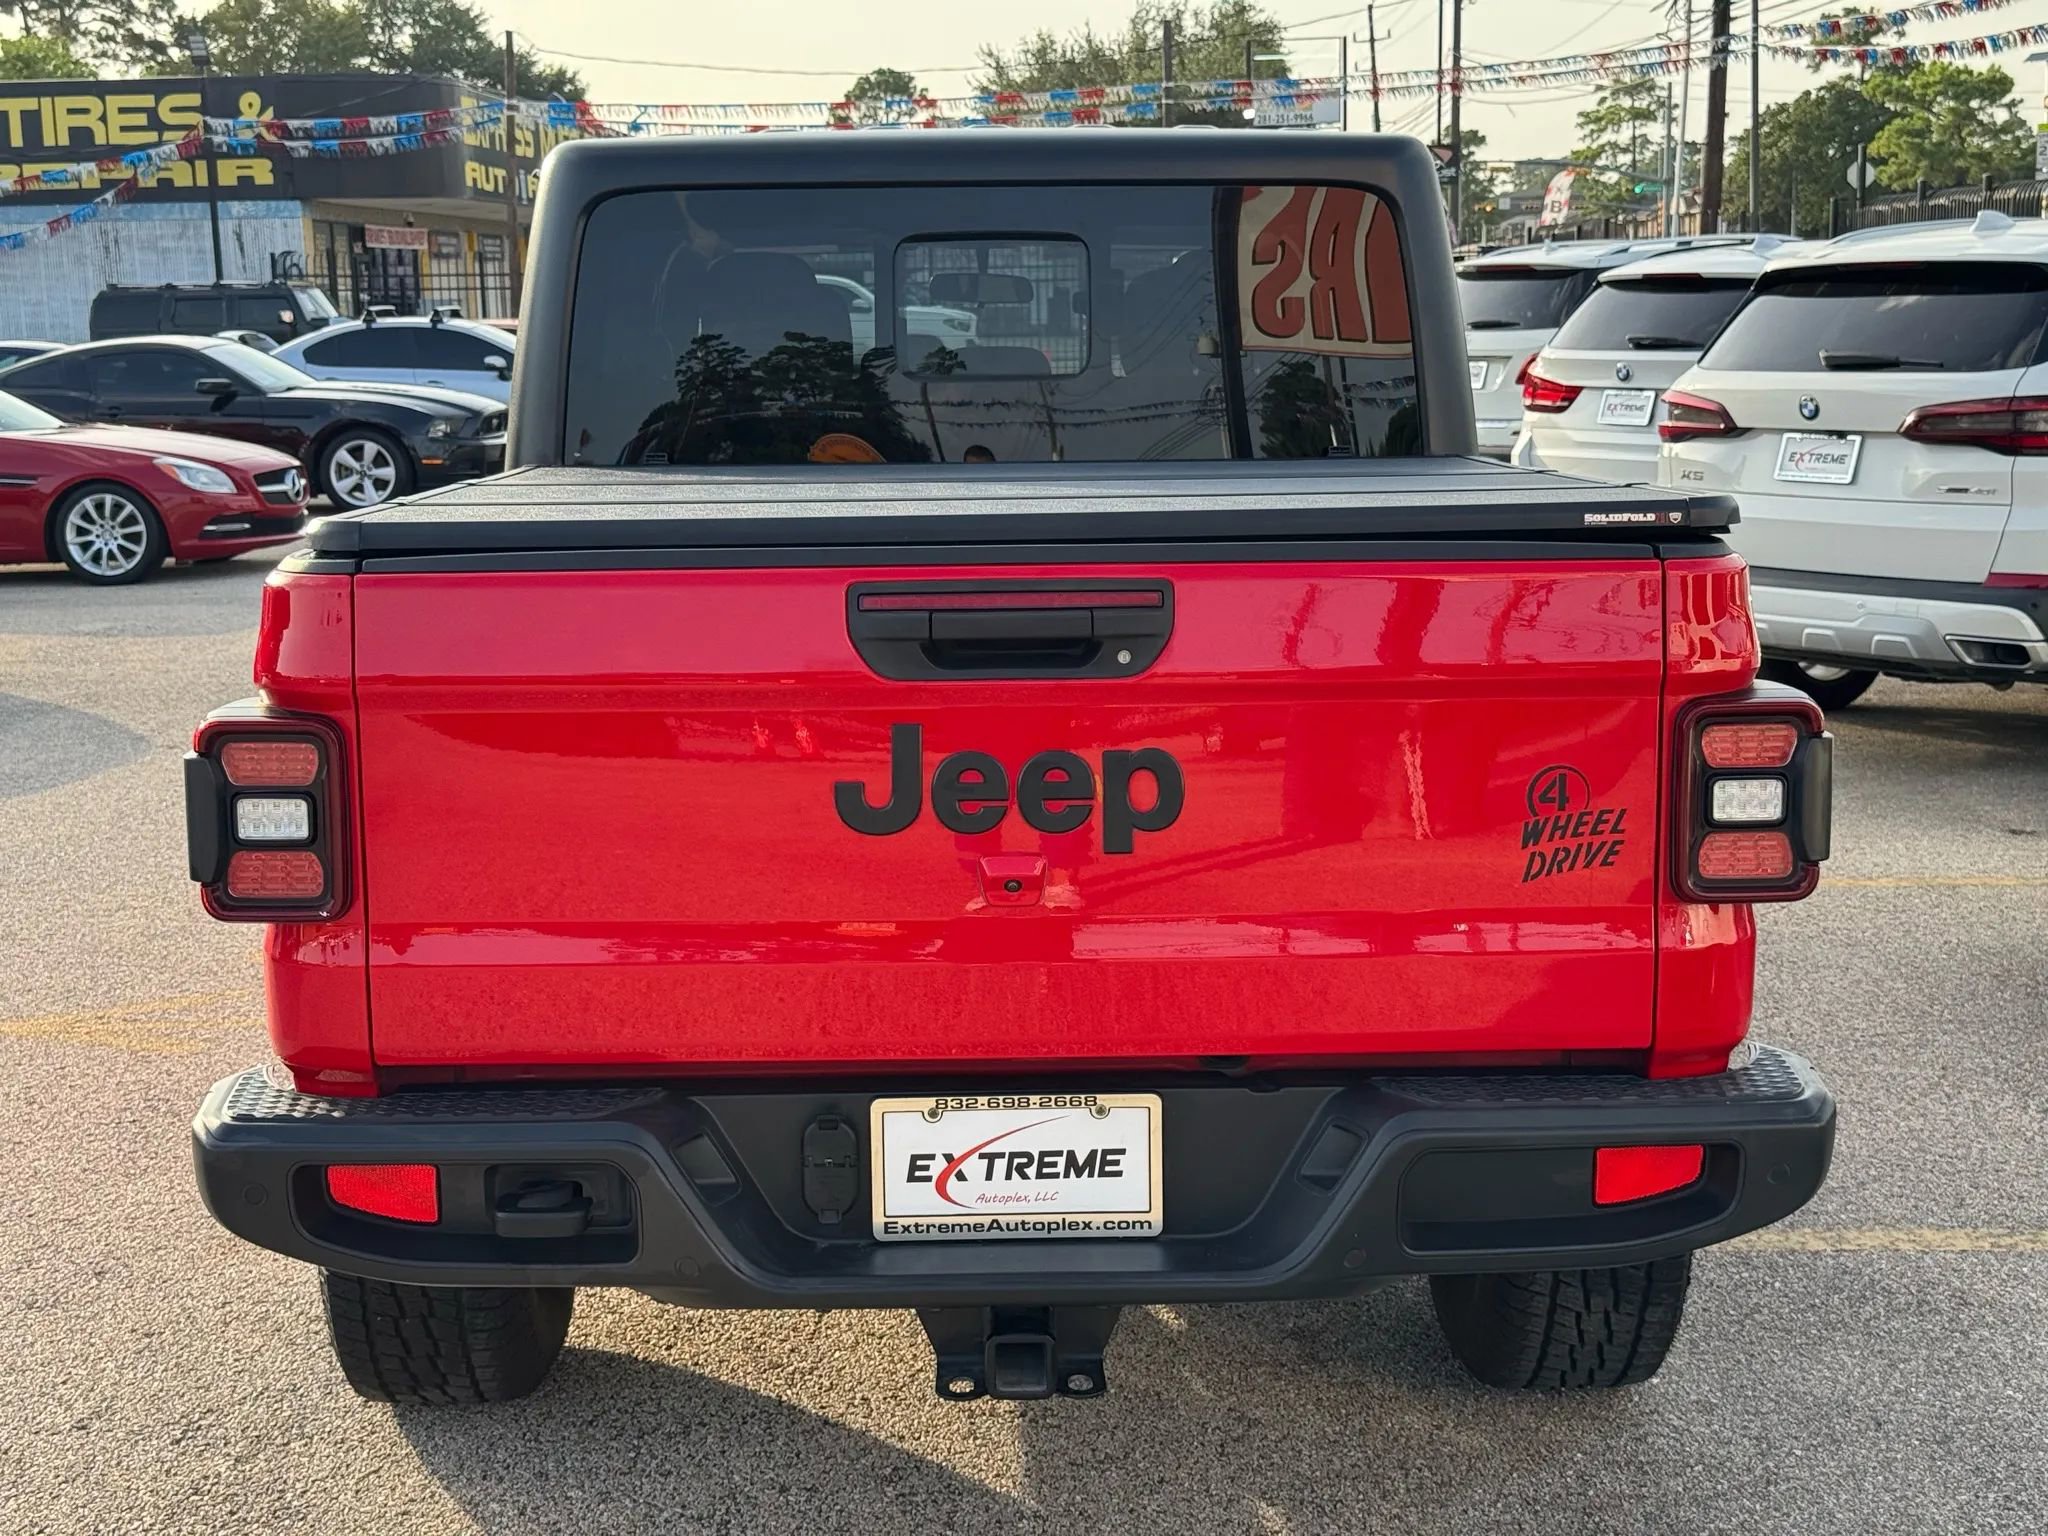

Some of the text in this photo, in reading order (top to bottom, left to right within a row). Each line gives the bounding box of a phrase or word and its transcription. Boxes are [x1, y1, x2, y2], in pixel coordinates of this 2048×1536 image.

[0, 94, 202, 148] TIRES
[1788, 451, 1848, 465] EXTREME
[1584, 512, 1655, 523] SOLIDFOLD
[834, 723, 1185, 854] Jeep
[1538, 773, 1569, 811] 4
[1521, 808, 1627, 849] WHEEL
[1522, 840, 1625, 883] DRIVE
[935, 1096, 1098, 1109] 832-698-2668
[906, 1148, 1127, 1183] EXTREME
[975, 1191, 1060, 1206] Autoplex, LLC
[883, 1217, 1153, 1235] ExtremeAutoplex.com
